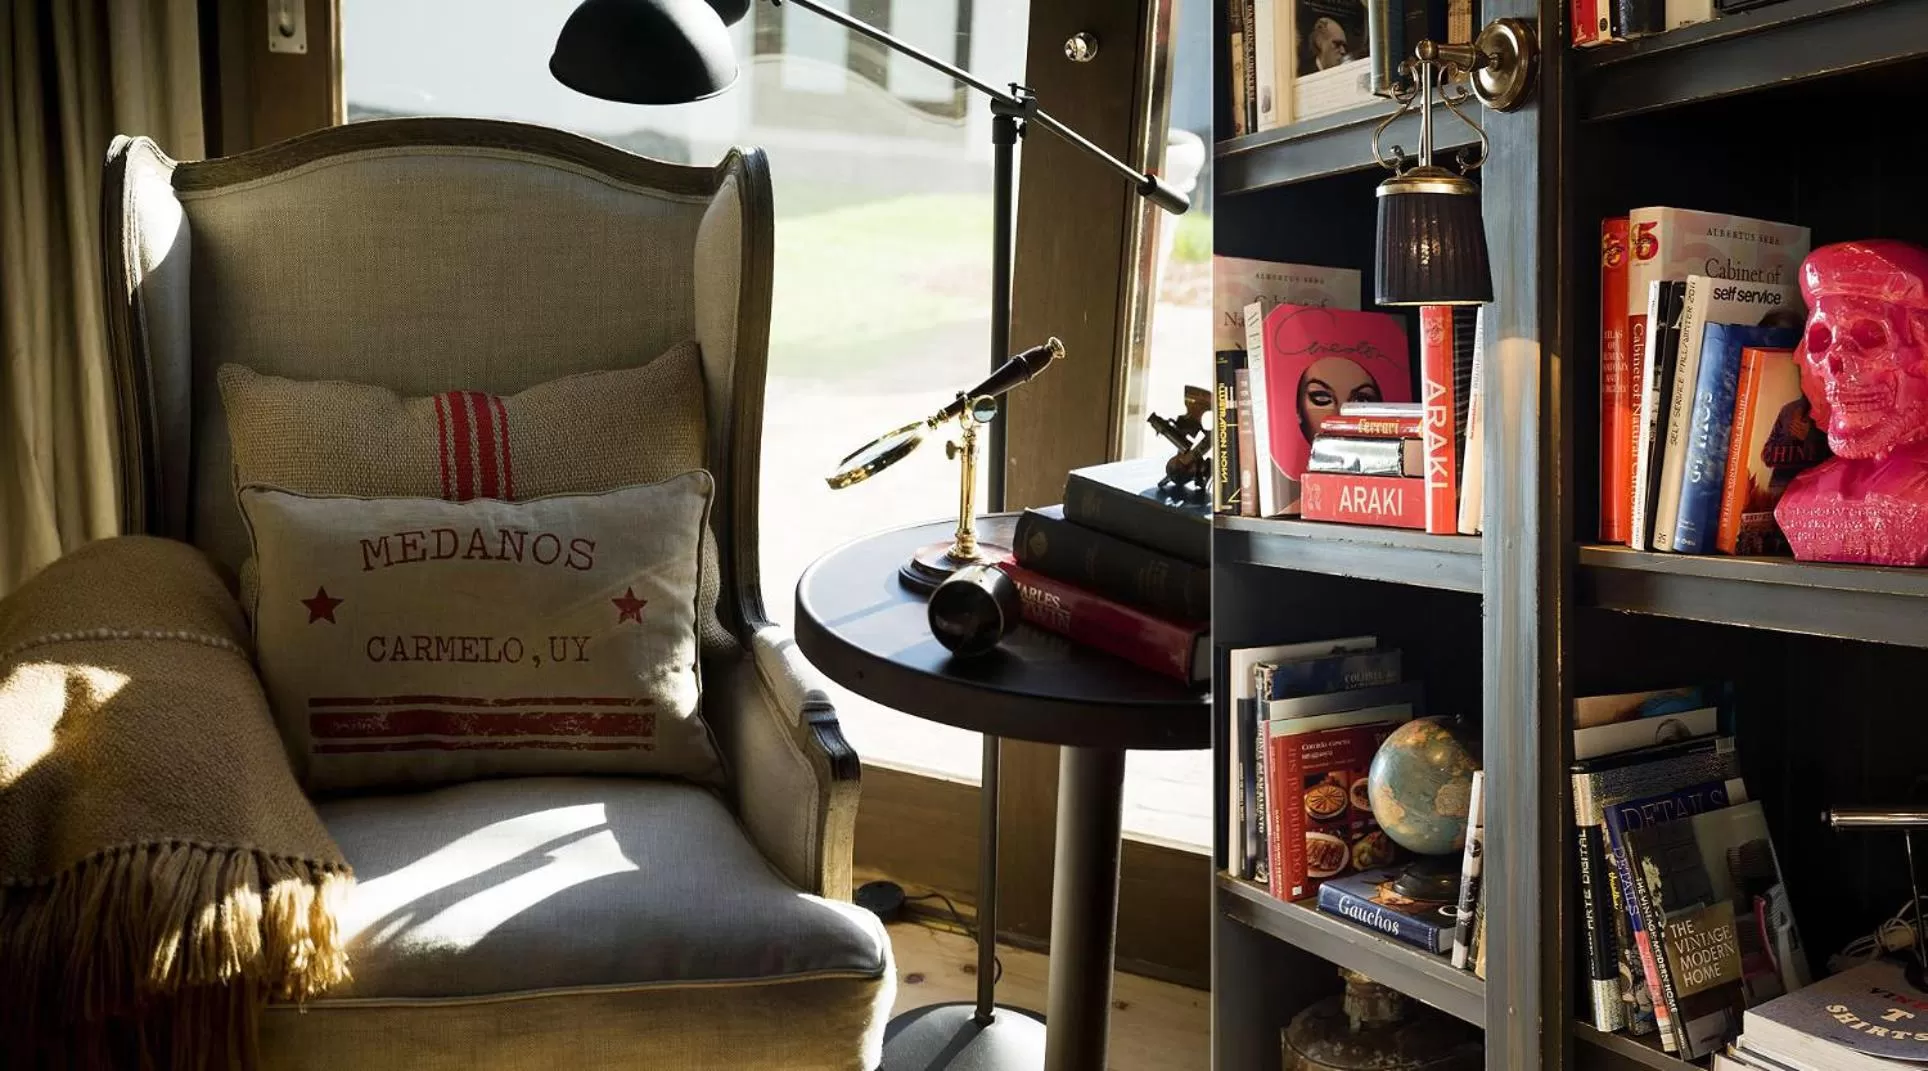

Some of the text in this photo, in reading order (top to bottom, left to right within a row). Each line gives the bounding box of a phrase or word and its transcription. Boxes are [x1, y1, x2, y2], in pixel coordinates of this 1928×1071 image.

[1705, 257, 1784, 285] Cabinet of
[1713, 286, 1782, 305] self service
[1632, 322, 1645, 382] Cabinet
[1632, 384, 1643, 399] of
[1219, 383, 1229, 449] ILLUSTRATION
[1357, 418, 1400, 435] Ferrari
[1425, 380, 1448, 489] ARAKI
[1339, 485, 1403, 517] ARAKI
[359, 527, 597, 573] MEDANOS
[1013, 580, 1061, 609] ARLES
[1578, 829, 1590, 884] DIGITAL
[1612, 846, 1640, 916] DETAILS
[1338, 894, 1400, 936] Gauchos
[1670, 919, 1695, 938] THE
[1635, 877, 1645, 894] THE
[1640, 895, 1658, 938] VINTAGE
[1651, 940, 1668, 981] MODERN
[1664, 983, 1678, 1014] HOME
[1674, 924, 1734, 955] VINTAGE
[1680, 943, 1736, 972] MODERN
[1684, 963, 1722, 988] HOME
[1825, 1004, 1928, 1041] SHIRTS
